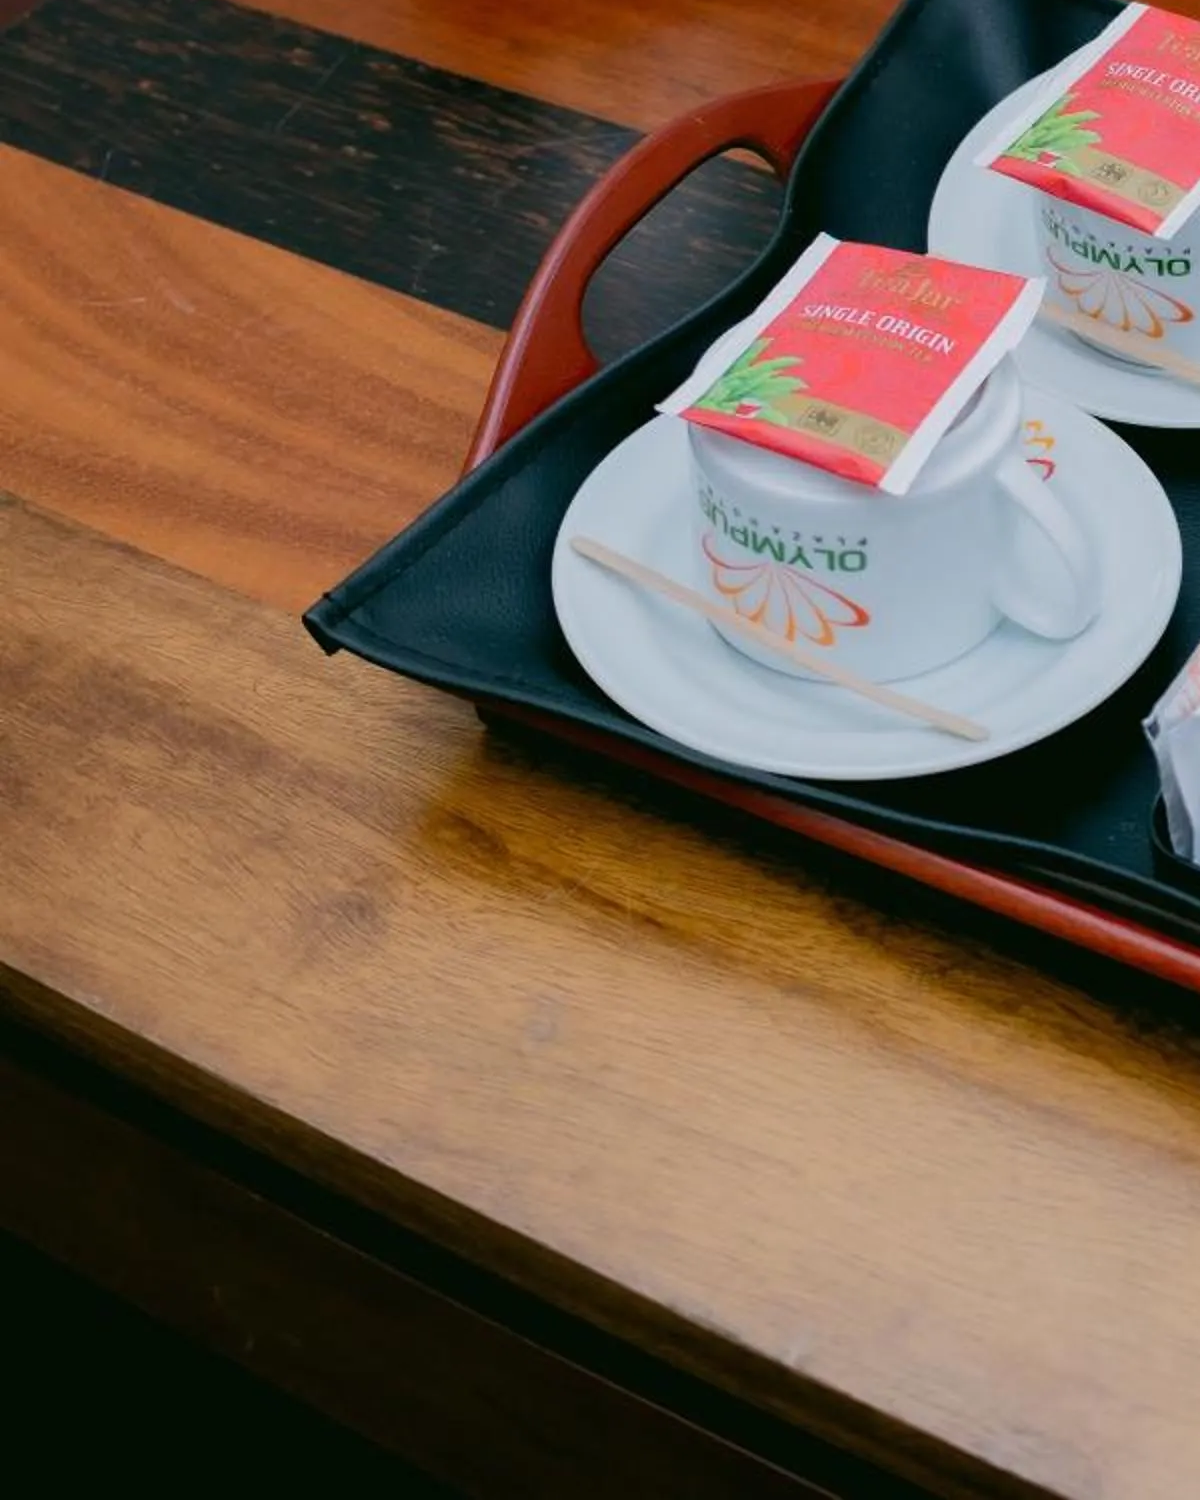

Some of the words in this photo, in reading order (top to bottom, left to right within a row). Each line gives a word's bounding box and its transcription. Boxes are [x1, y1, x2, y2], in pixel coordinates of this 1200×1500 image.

[1105, 60, 1166, 88] SINGLE
[801, 301, 875, 327] SINGLE
[876, 314, 956, 356] ORIGIN
